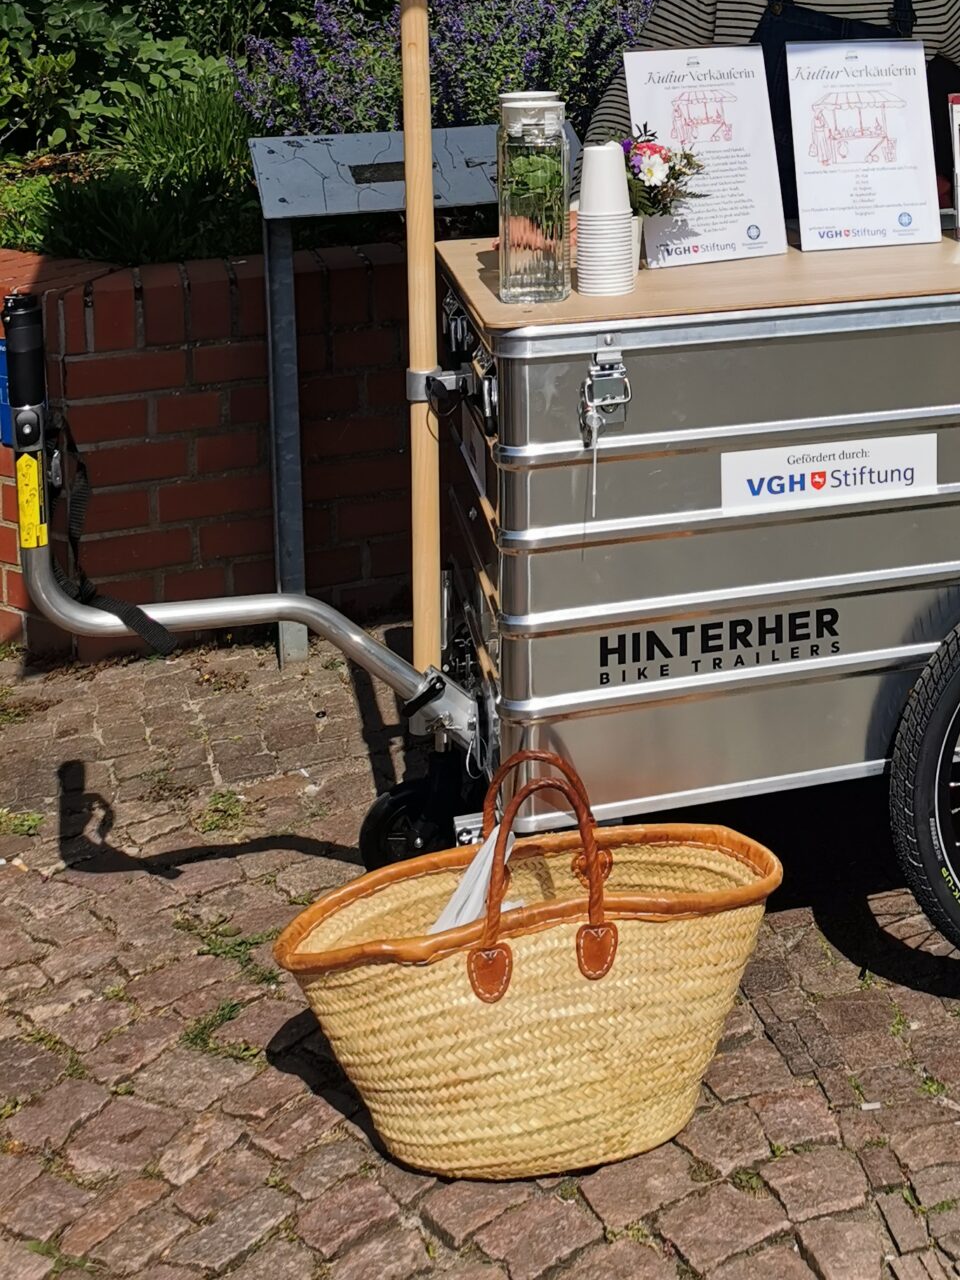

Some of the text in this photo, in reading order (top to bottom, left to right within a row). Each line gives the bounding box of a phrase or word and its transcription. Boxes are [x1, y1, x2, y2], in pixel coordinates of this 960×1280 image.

[818, 230, 842, 239] VGH
[851, 227, 887, 240] Stiftung
[666, 246, 691, 257] VGH
[700, 241, 737, 255] Stiftung
[786, 448, 870, 466] Gefördert durch:
[746, 466, 915, 497] VGH Stiftung
[600, 607, 839, 668] HINTERHER
[600, 640, 840, 685] BIKE TRAILERS
